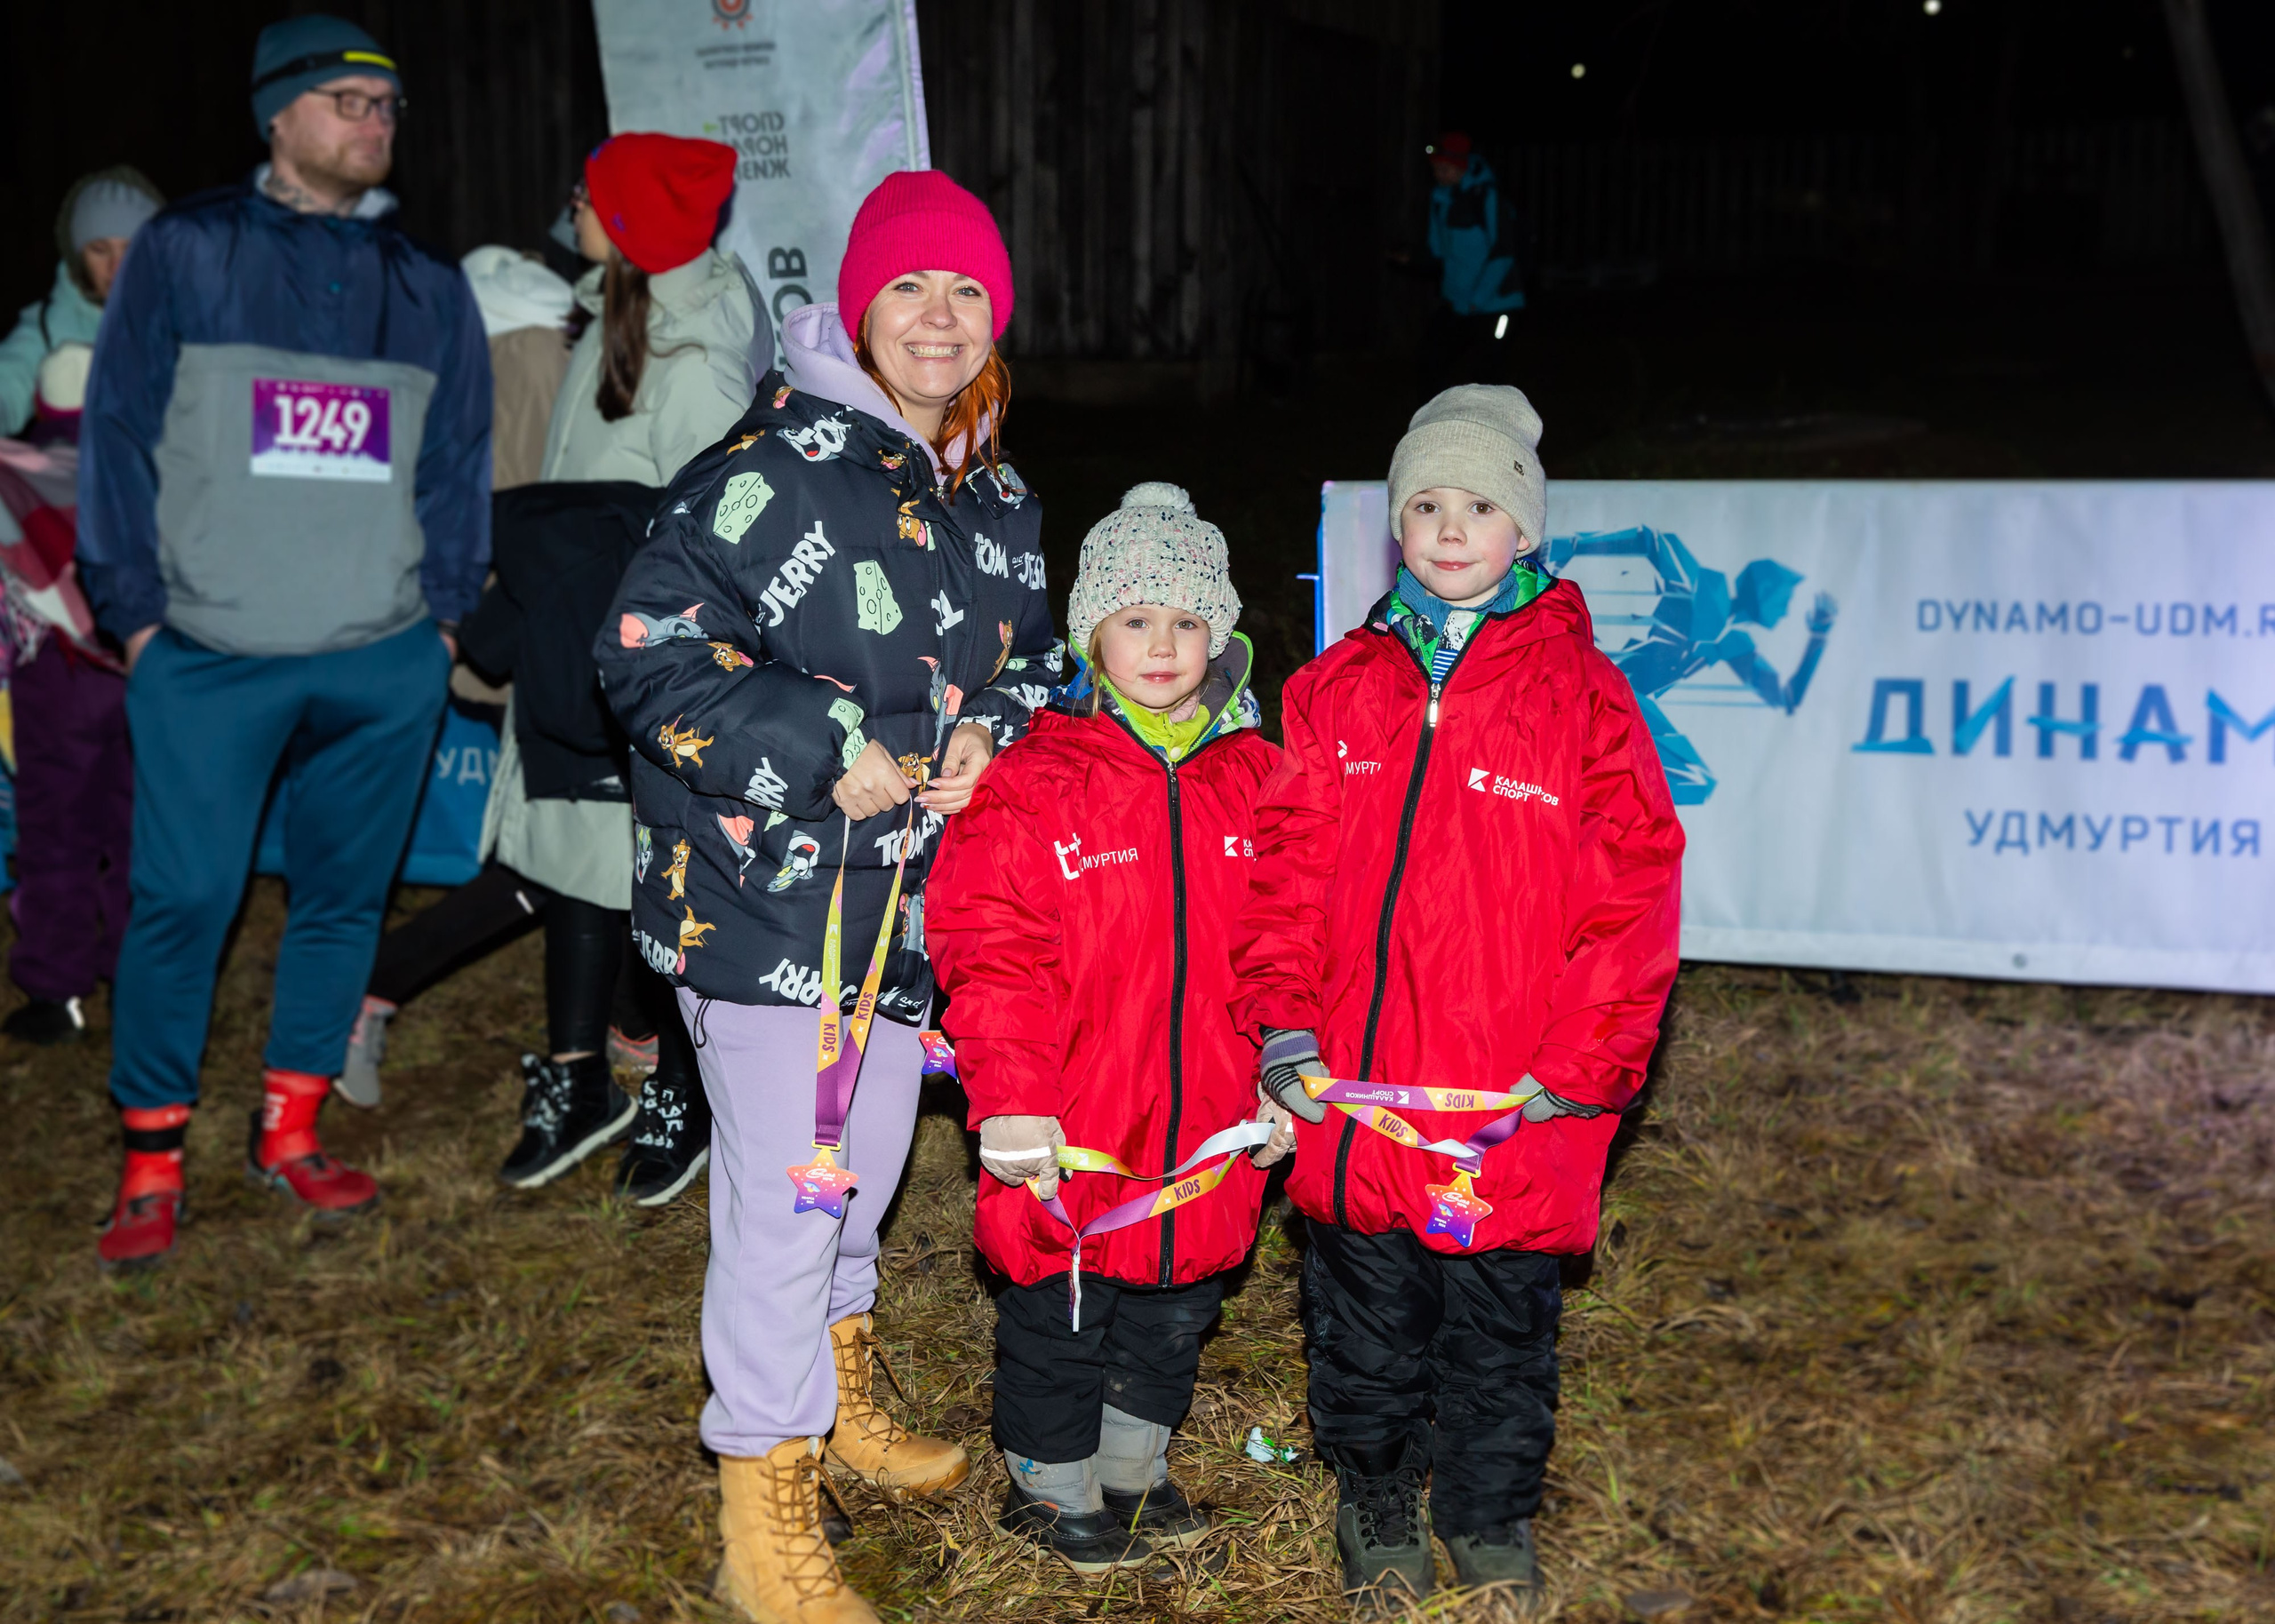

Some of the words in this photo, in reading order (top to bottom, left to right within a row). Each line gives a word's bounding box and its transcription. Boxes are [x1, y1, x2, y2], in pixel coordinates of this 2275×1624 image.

[275, 395, 371, 450] 1249
[974, 532, 1010, 579] TOM
[760, 521, 836, 627] JERRY
[1492, 784, 1530, 802] СПОРТ
[1965, 808, 2261, 857] УДМУРТИЯ
[856, 991, 874, 1021] KIDS
[821, 1023, 837, 1053] KIDS
[1345, 1092, 1393, 1102] КАЛАШНИКОВ
[1445, 1092, 1474, 1109] KIDS
[1377, 1113, 1409, 1138] KIDS
[1173, 1178, 1201, 1202] KIDS
